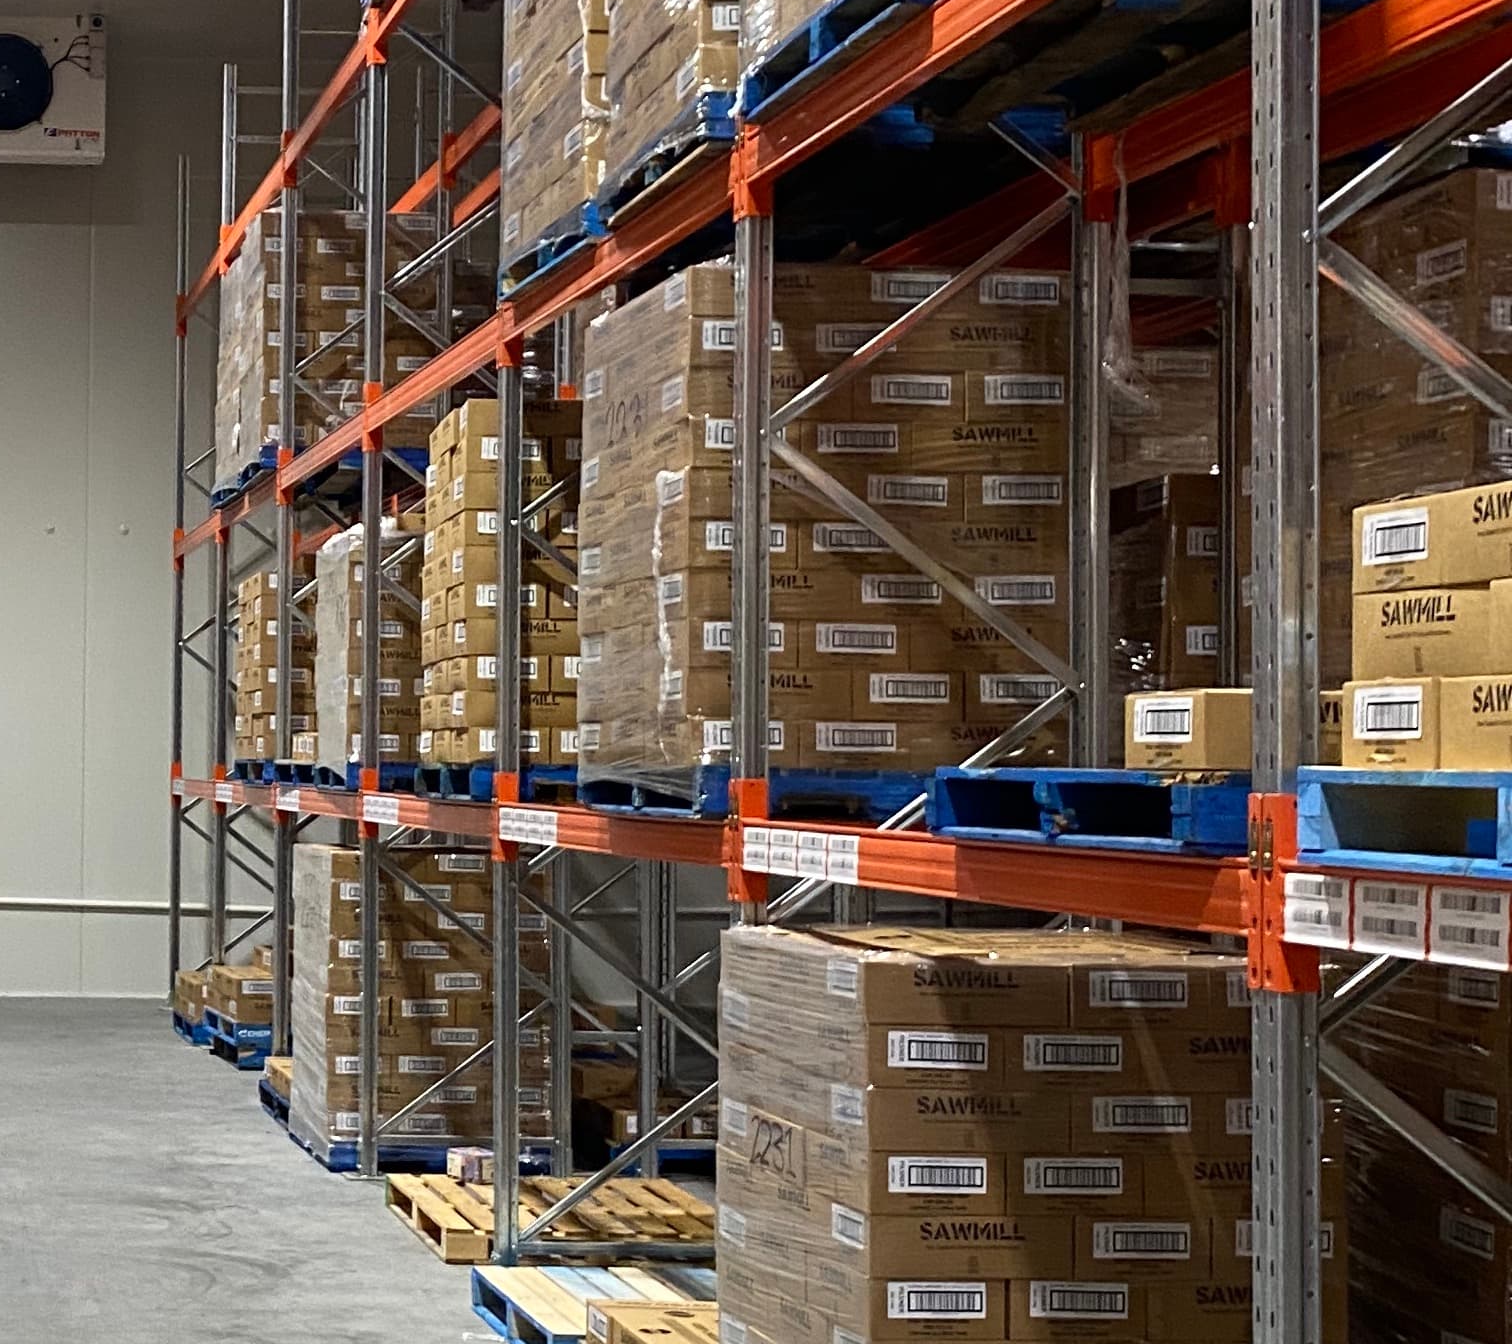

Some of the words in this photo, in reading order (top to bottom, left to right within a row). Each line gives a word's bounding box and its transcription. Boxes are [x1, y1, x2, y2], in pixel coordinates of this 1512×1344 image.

[950, 326, 1034, 342] SAWMILL
[952, 427, 1038, 442] SAWMILL
[951, 527, 1037, 542] SAWMILL
[771, 575, 814, 589] MILL
[1381, 595, 1456, 626] SAWMILL
[770, 675, 813, 689] MILL
[914, 969, 1020, 988] SAWMILL
[917, 1096, 1022, 1115] SAWMILL
[920, 1222, 1026, 1241] SAWMILL
